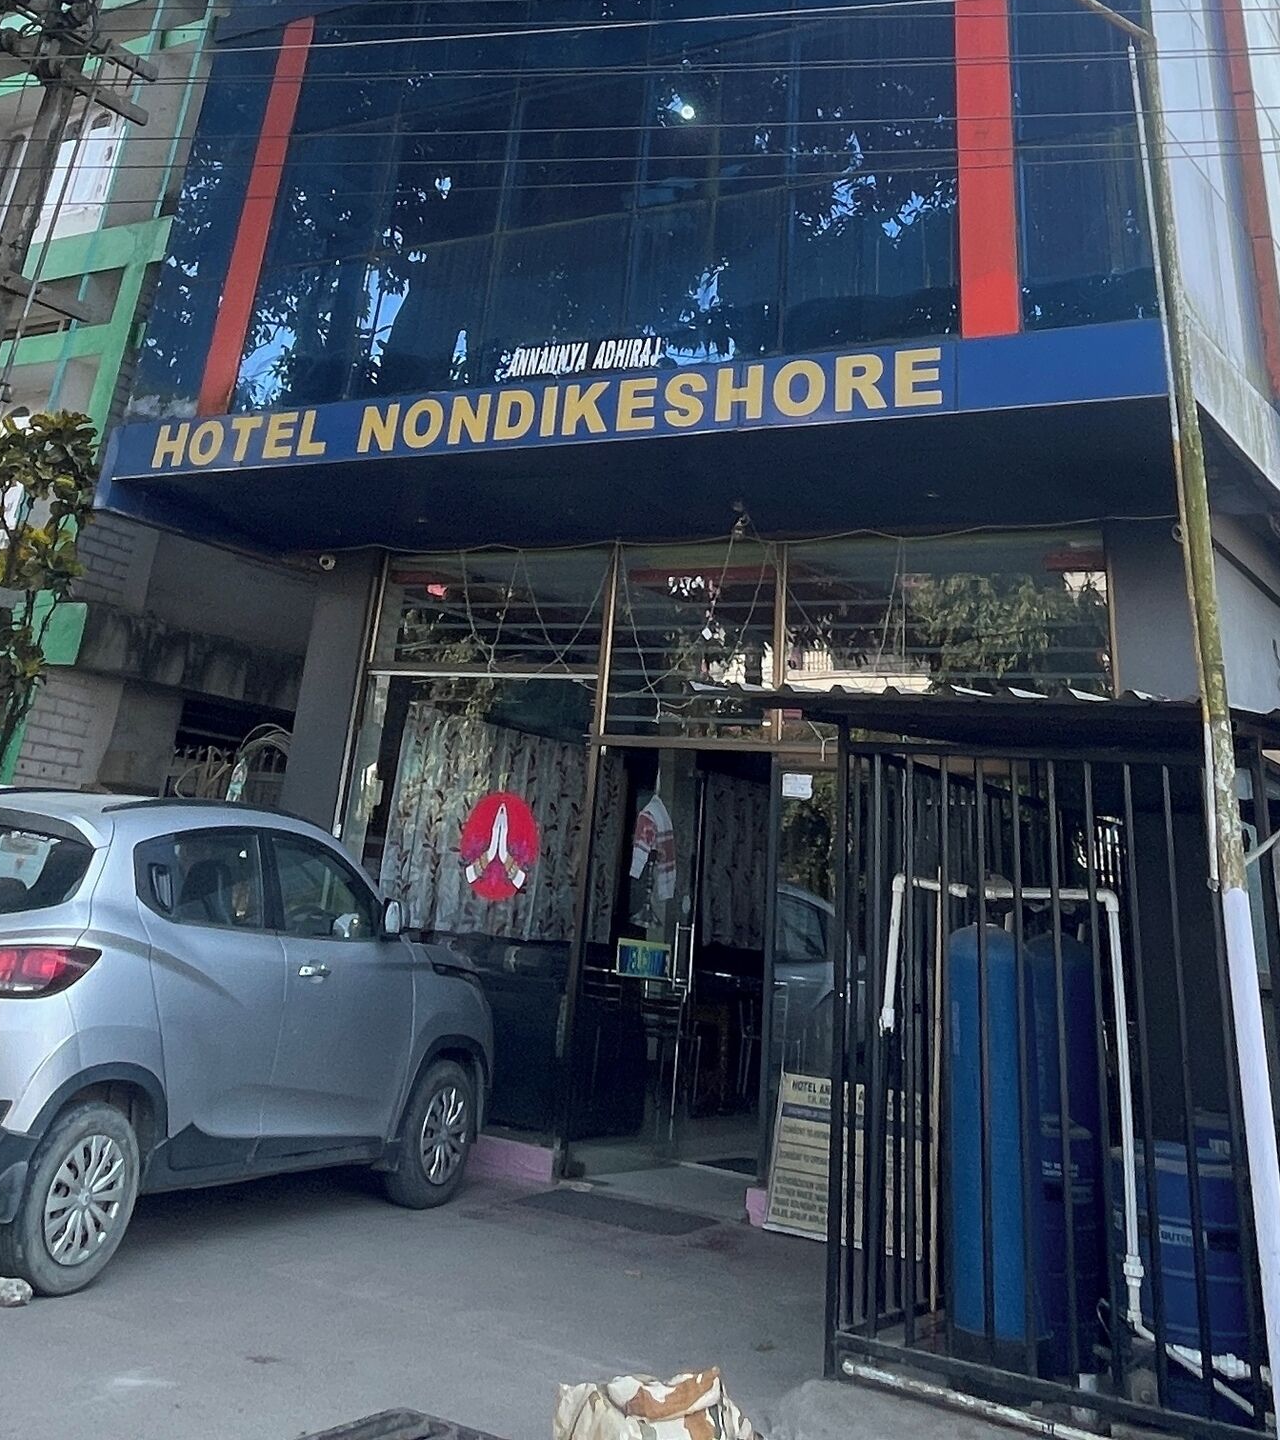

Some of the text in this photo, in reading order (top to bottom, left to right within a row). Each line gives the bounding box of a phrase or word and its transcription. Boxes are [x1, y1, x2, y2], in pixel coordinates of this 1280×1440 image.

[591, 337, 661, 370] ADHIRAJ
[151, 347, 943, 469] HOTEL NONDIKESHORE
